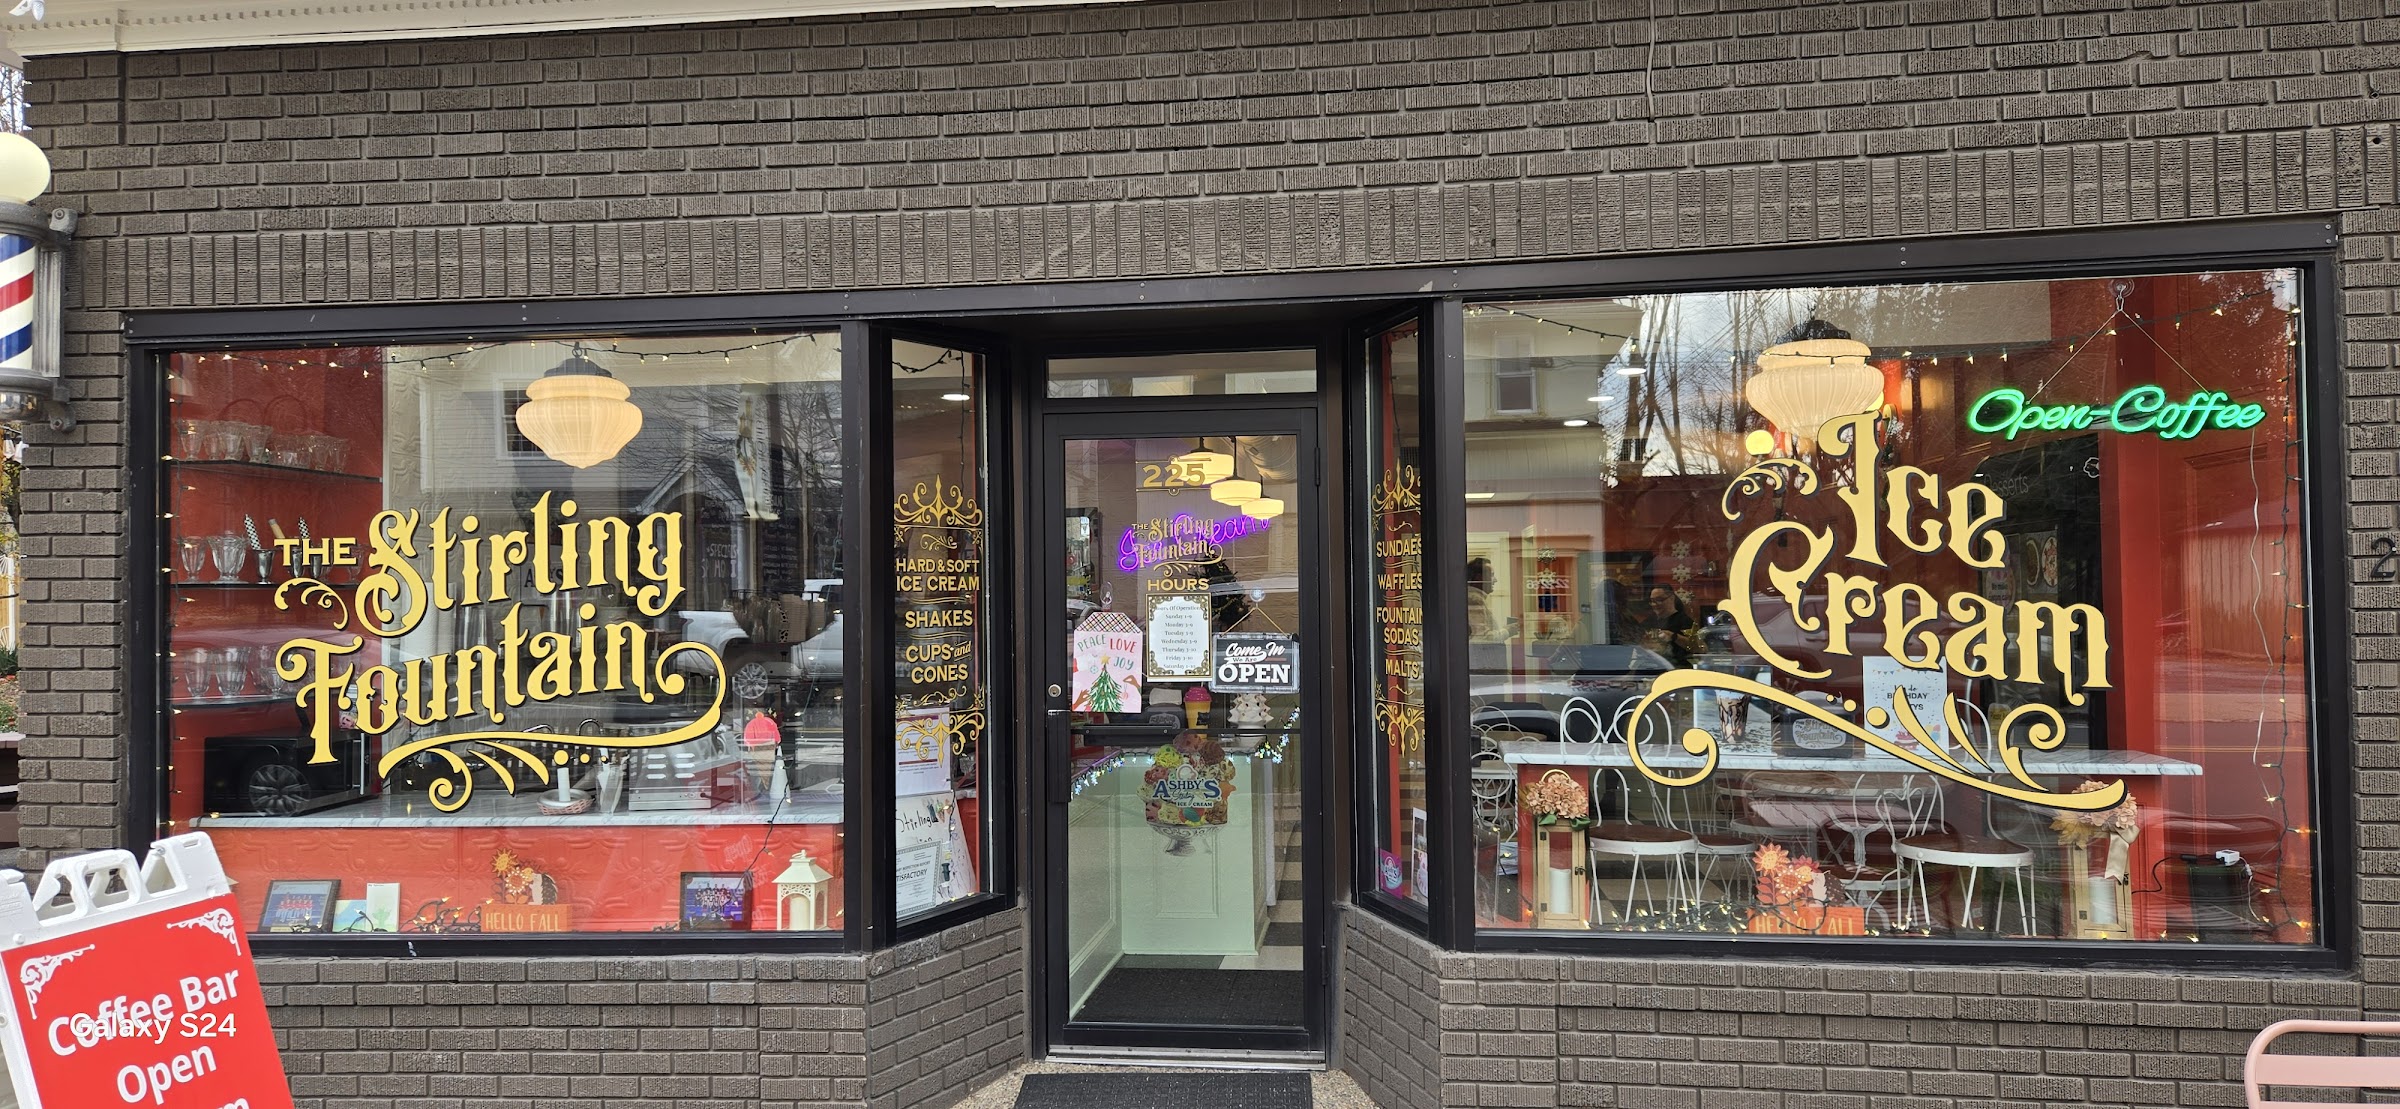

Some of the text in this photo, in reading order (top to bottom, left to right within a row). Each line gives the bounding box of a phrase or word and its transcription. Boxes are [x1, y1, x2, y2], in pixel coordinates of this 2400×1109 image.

[1968, 384, 2266, 440] Open-Coffee
[1142, 463, 1206, 488] 225
[1817, 410, 2008, 569] Ice
[1148, 517, 1214, 542] Stirling
[1133, 537, 1210, 568] Fountain
[1376, 538, 1422, 558] SUNDAES
[2370, 537, 2396, 578] 2
[273, 537, 357, 567] THE
[353, 490, 686, 637] Stirling
[895, 558, 980, 573] HARD & SOFT
[896, 575, 980, 592] ICE CREAM
[1147, 578, 1210, 591] HOURS
[1377, 572, 1422, 590] WAFFLES
[905, 610, 973, 629] SHAKES
[1717, 520, 2113, 708] Cream
[1077, 633, 1137, 653] PEACE LOVE
[1384, 627, 1419, 646] SODAS
[905, 641, 972, 663] CUPS and
[1225, 641, 1286, 657] Come In
[911, 663, 969, 684] CONES
[1113, 656, 1134, 671] JOY
[1385, 658, 1420, 679] MALTS
[275, 602, 656, 766] Fountain
[1218, 664, 1291, 684] OPEN
[1152, 780, 1222, 799] ASHBY'S
[896, 869, 928, 882] TISFACTORY
[485, 912, 562, 931] HELLO FALL
[48, 969, 239, 1056] Coffee Bar
[117, 1045, 217, 1105] Open
